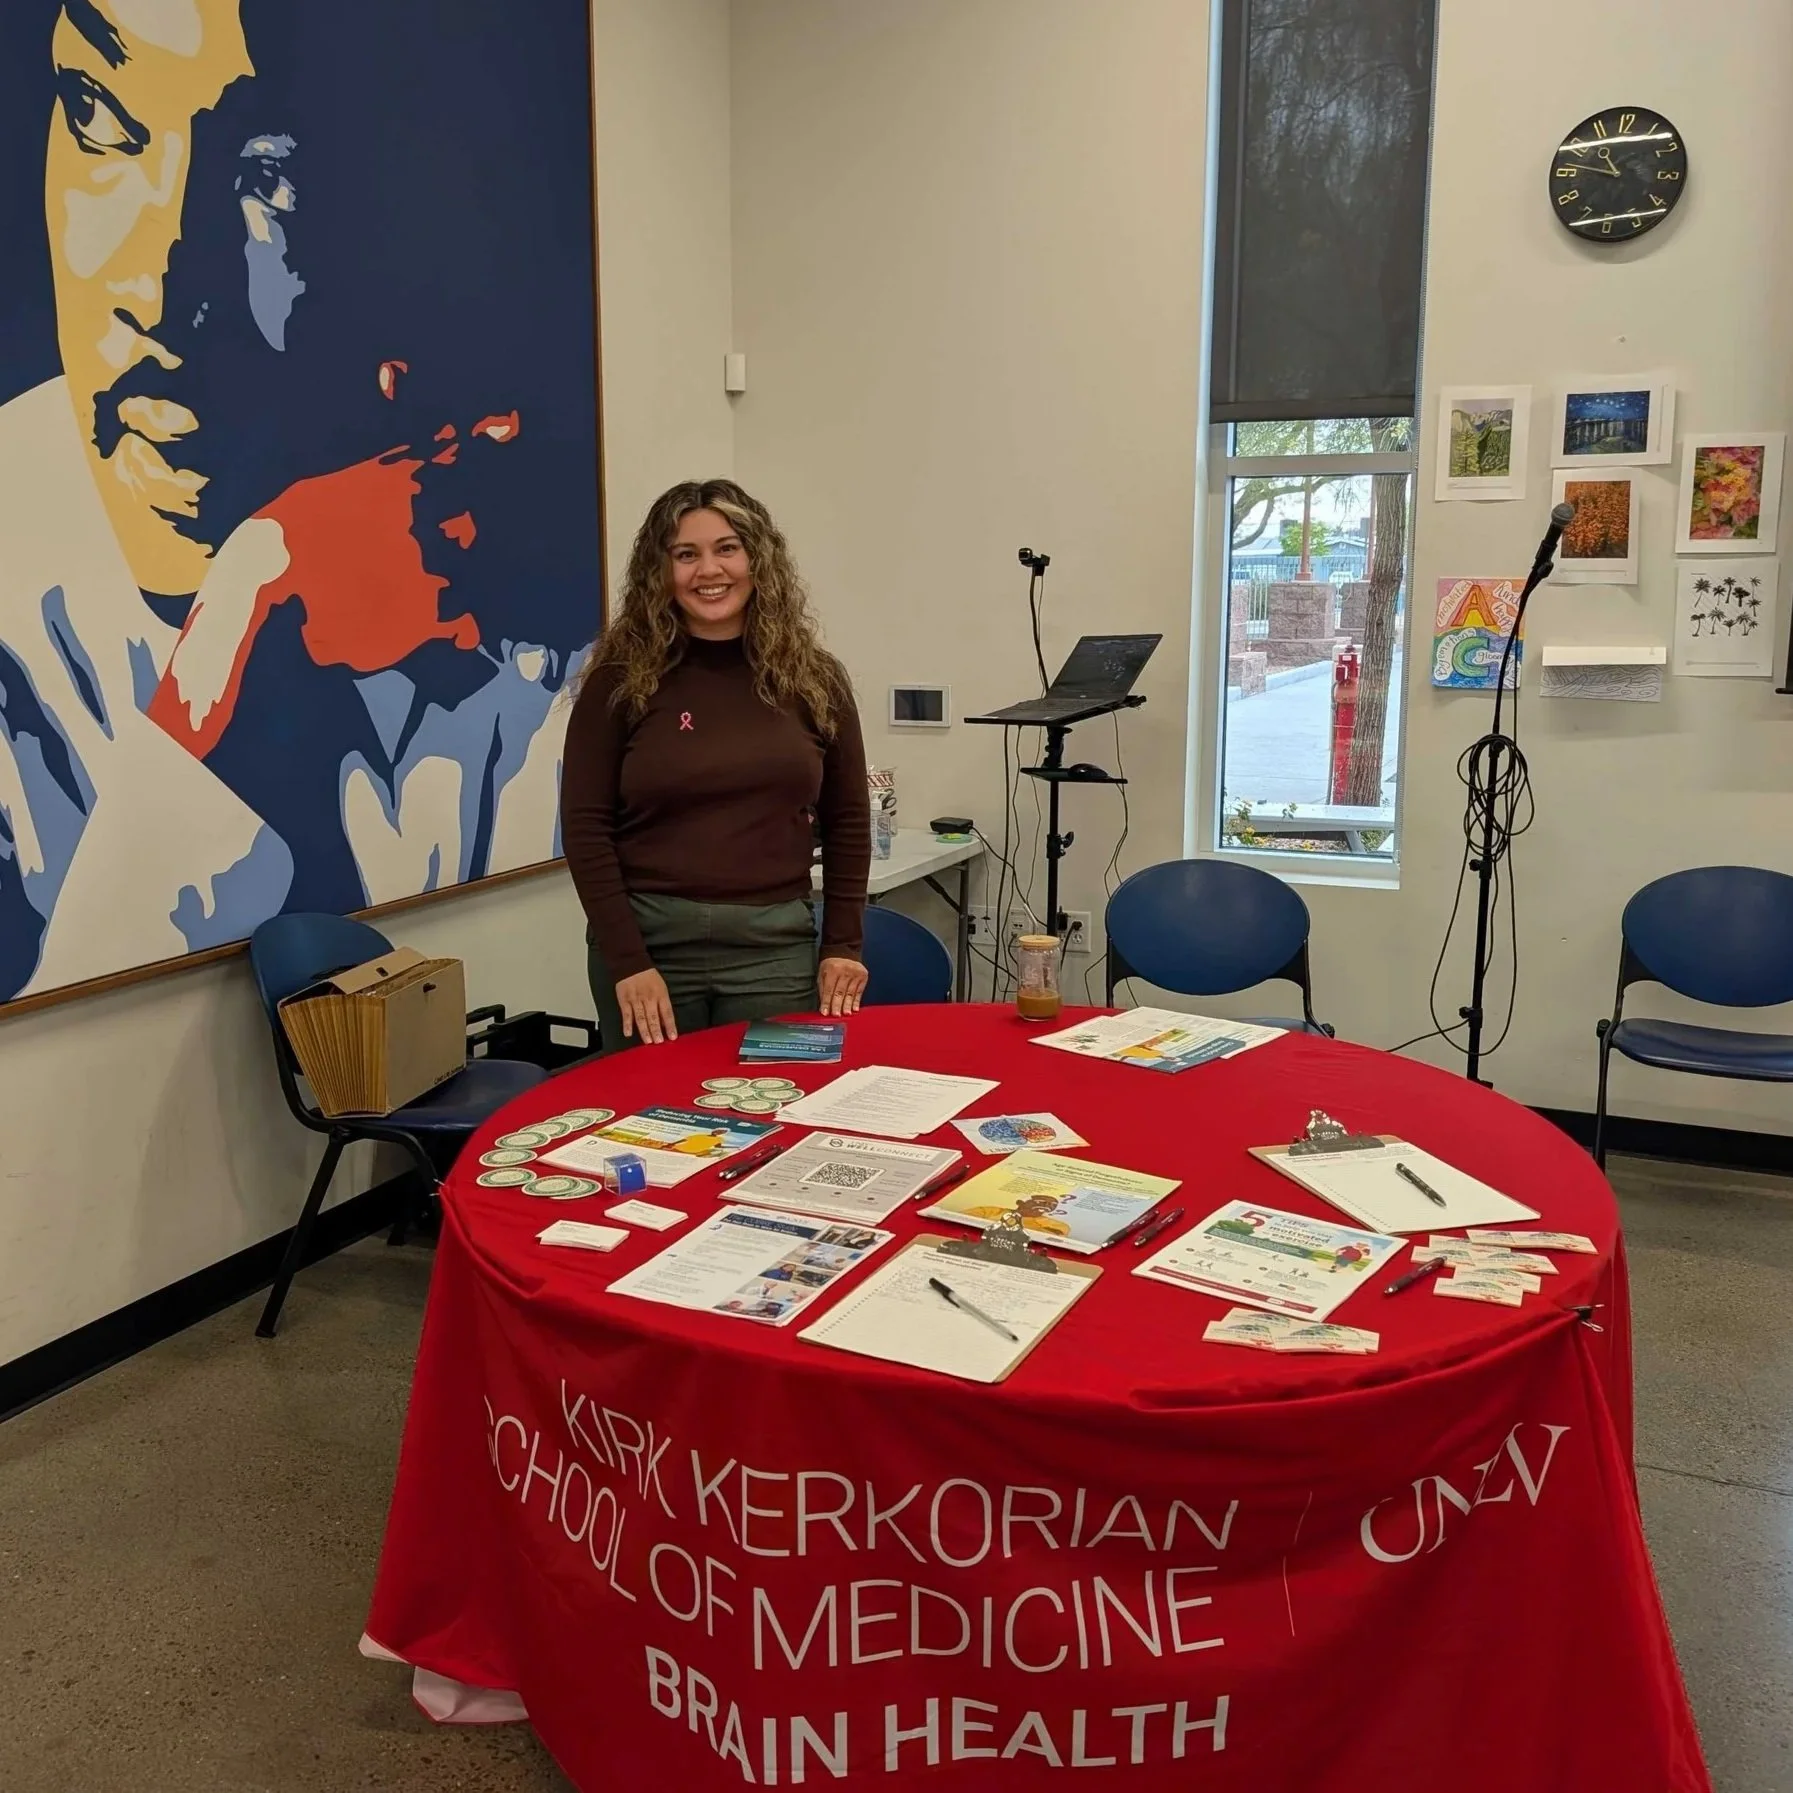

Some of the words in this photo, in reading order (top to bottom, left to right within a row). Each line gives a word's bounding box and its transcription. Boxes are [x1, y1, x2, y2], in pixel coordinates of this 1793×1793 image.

[1593, 120, 1608, 138] 11
[1619, 114, 1636, 134] 12
[1655, 142, 1679, 158] 2
[1556, 168, 1577, 177] 9
[1657, 171, 1680, 180] 3
[1558, 189, 1579, 206] 8
[1649, 193, 1667, 207] 4
[1580, 206, 1593, 220] 7
[1451, 584, 1497, 627] A
[1453, 637, 1489, 678] C
[1240, 1210, 1273, 1227] 5
[1269, 1226, 1331, 1244] motivated
[1271, 1233, 1323, 1248] exercise
[562, 1378, 677, 1520] KIRK
[691, 1448, 1239, 1568] KERKORIAN
[1359, 1422, 1572, 1564] UNLV
[649, 1543, 737, 1637] OF
[752, 1566, 1225, 1673] MEDICINE
[645, 1645, 848, 1786] BRAIN
[884, 1695, 1231, 1773] HEALTH
